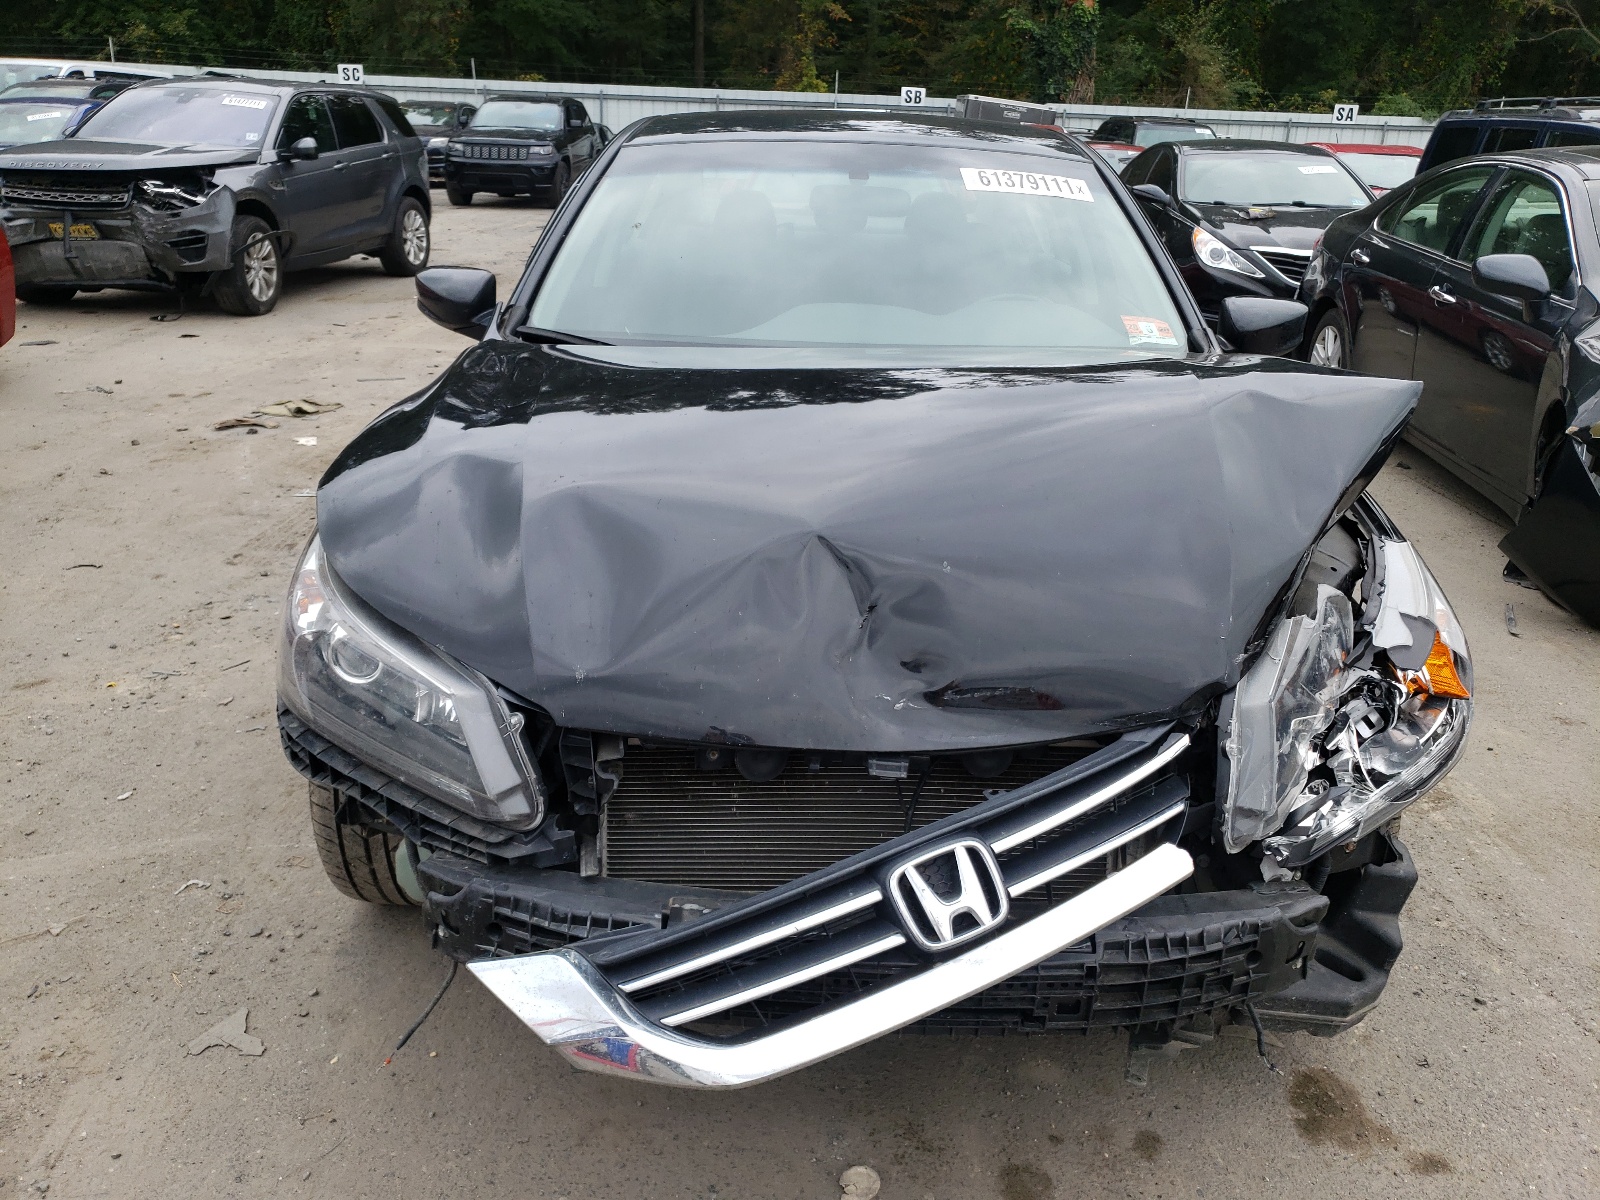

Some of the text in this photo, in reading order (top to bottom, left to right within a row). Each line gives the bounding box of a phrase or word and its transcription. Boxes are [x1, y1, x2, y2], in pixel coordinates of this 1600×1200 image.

[342, 67, 360, 81] SC
[904, 89, 922, 104] SB
[1336, 107, 1354, 121] SA
